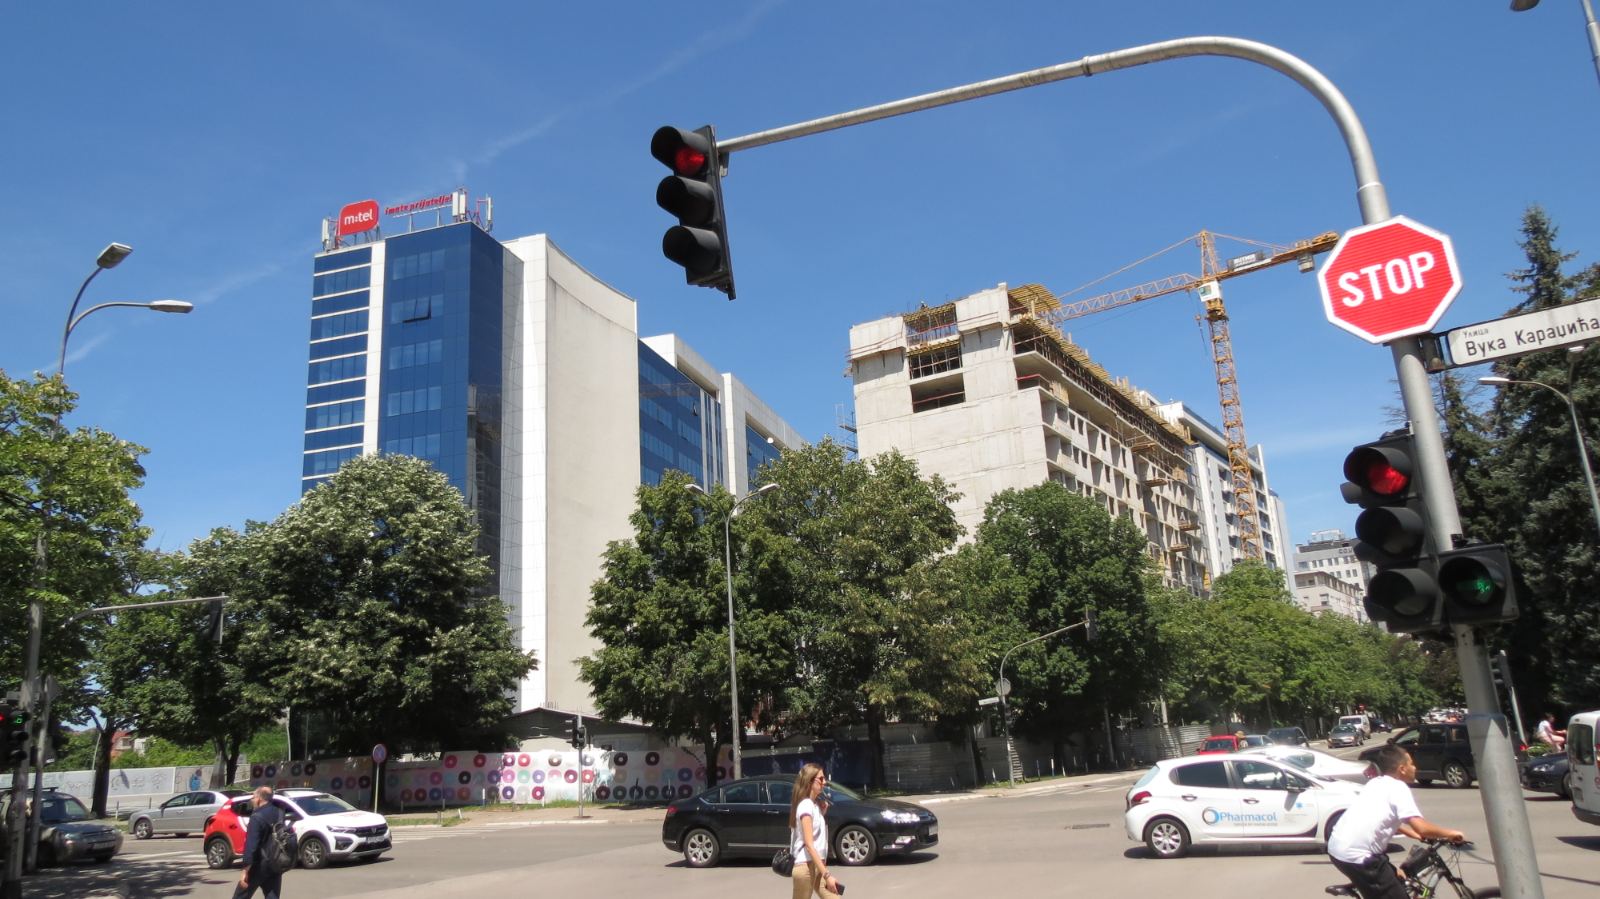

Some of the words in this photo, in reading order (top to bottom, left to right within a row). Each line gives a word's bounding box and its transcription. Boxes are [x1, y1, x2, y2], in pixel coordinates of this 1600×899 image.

[344, 208, 374, 225] m:tel
[1338, 251, 1435, 307] STOP
[1462, 327, 1489, 339] Улица
[1465, 337, 1507, 357] Вука
[1514, 316, 1600, 346] Караџића
[1220, 811, 1277, 822] Pharmacol
